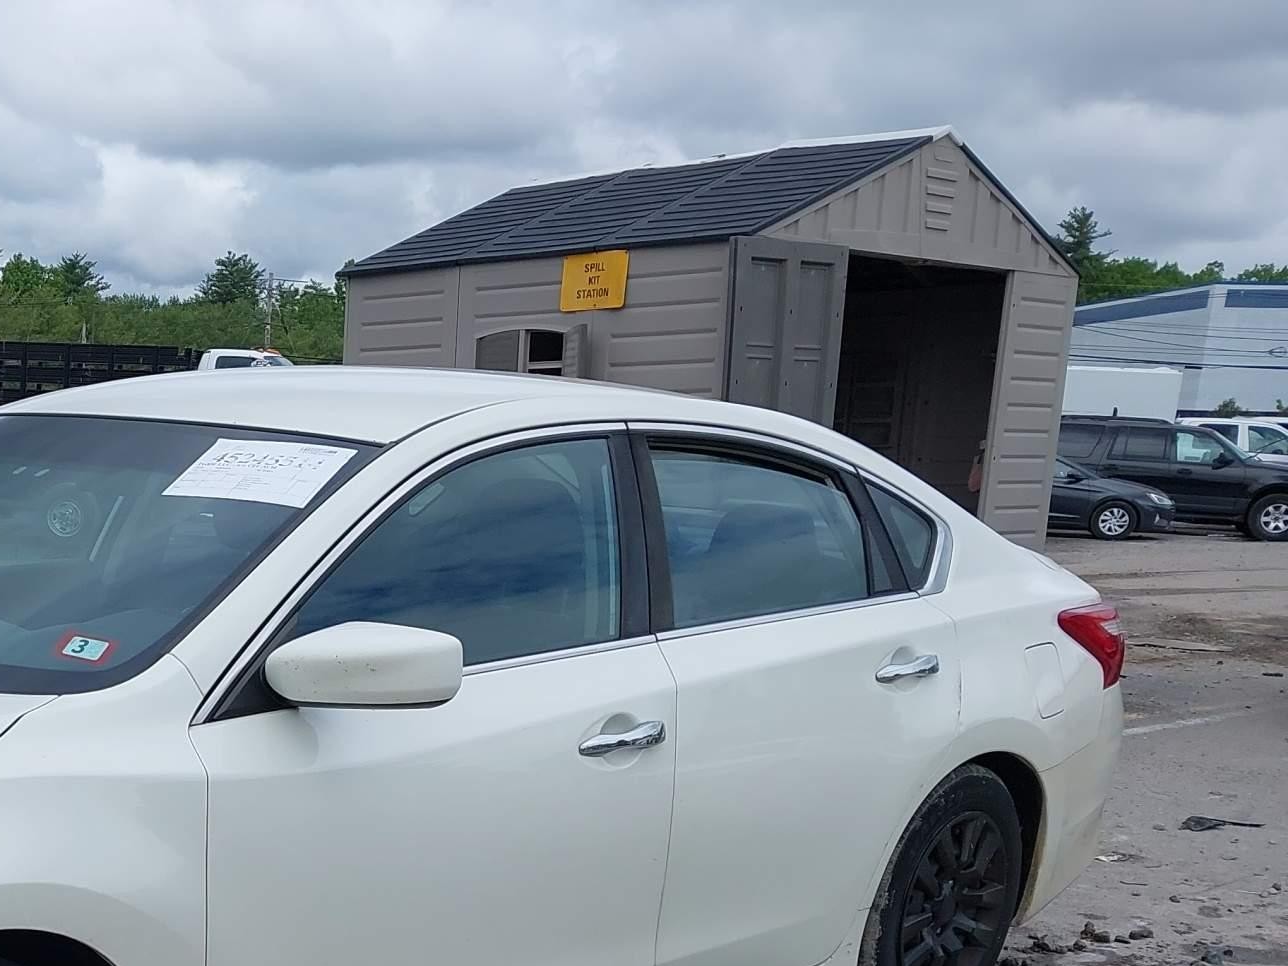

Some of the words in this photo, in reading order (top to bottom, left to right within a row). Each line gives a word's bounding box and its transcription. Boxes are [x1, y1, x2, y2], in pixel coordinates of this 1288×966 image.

[584, 262, 605, 273] SPILL
[588, 275, 600, 286] KIT
[576, 287, 609, 299] STATION
[71, 639, 90, 654] 3
